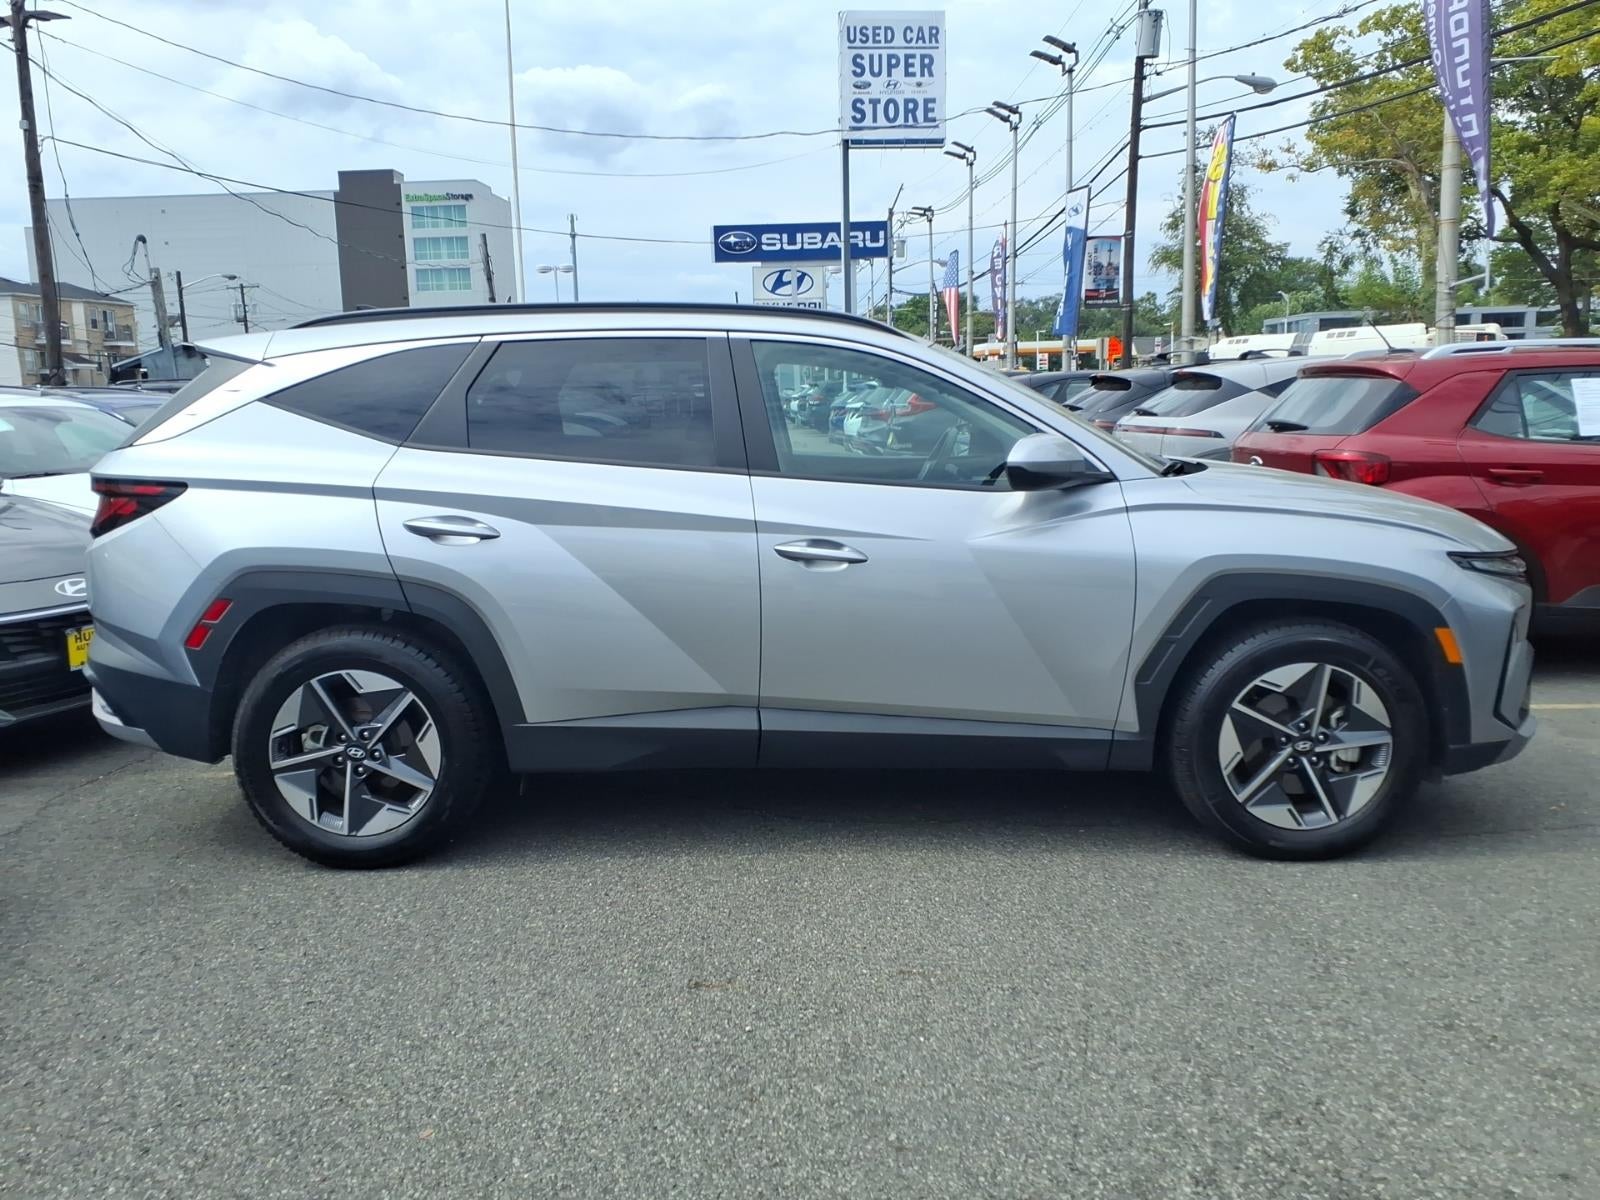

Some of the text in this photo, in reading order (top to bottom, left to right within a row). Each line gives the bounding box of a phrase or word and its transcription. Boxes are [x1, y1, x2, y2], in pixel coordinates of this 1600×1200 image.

[846, 25, 940, 45] USED CAR
[851, 53, 935, 78] SUPER
[851, 97, 937, 124] STORE
[761, 230, 885, 251] SUBARU
[74, 630, 94, 644] HU
